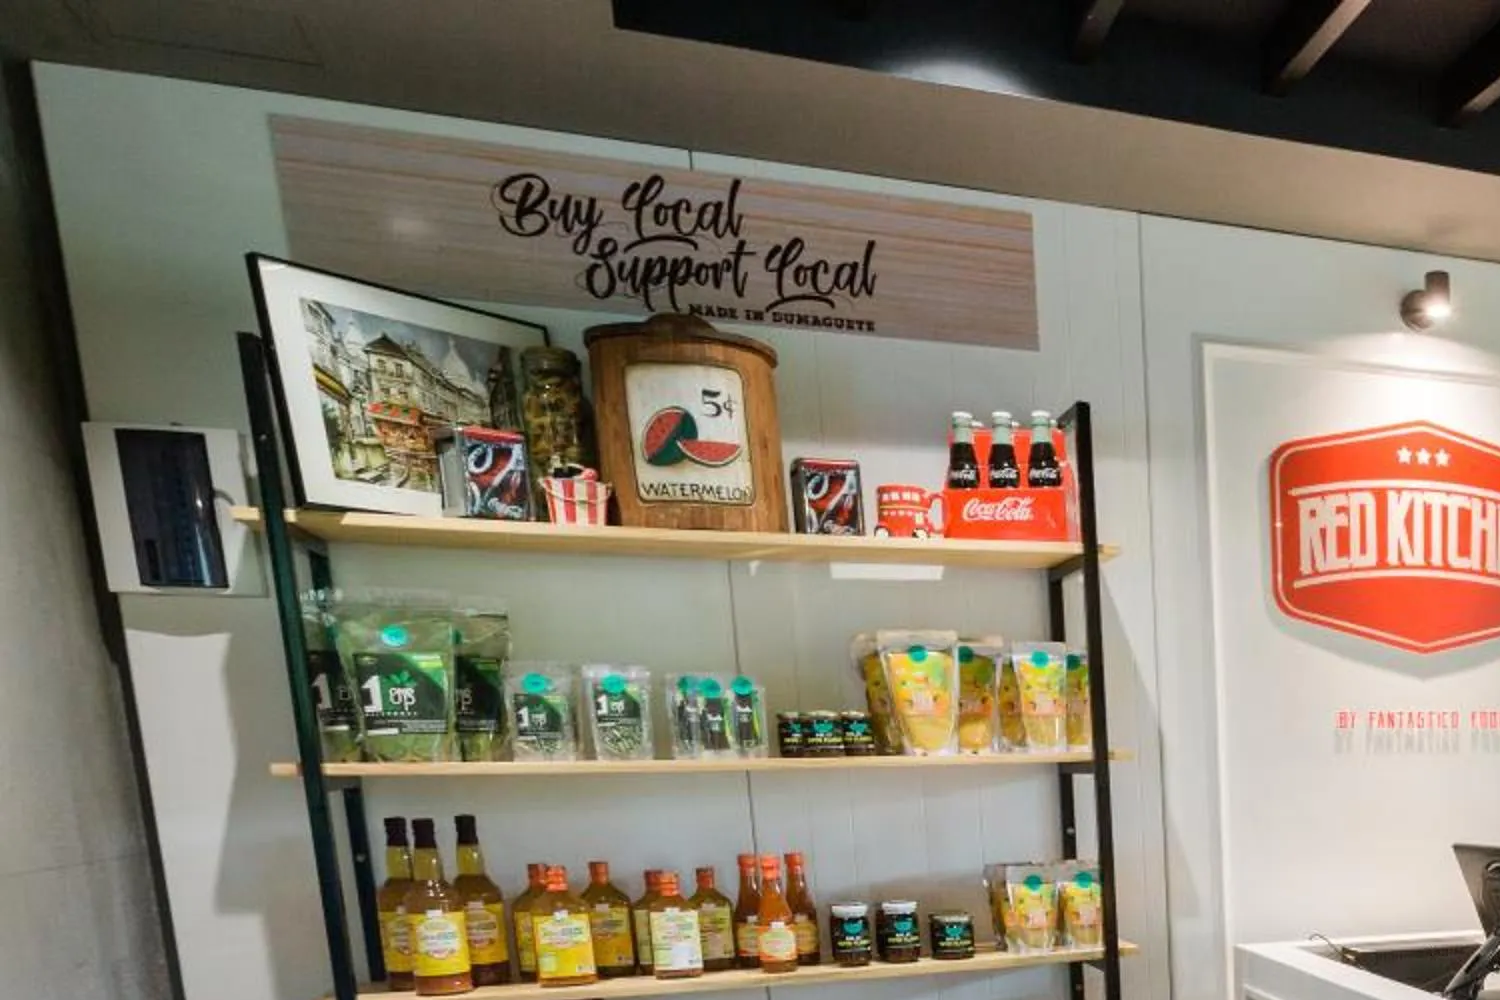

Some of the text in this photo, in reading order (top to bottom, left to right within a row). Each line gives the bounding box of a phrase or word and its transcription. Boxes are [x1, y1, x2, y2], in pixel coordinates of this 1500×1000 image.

[499, 172, 744, 255] Buy Local
[585, 237, 879, 312] Support Local
[688, 303, 875, 332] MADE IN DUMAGUETE
[641, 483, 751, 500] WATERMELON
[1297, 490, 1377, 576] RED
